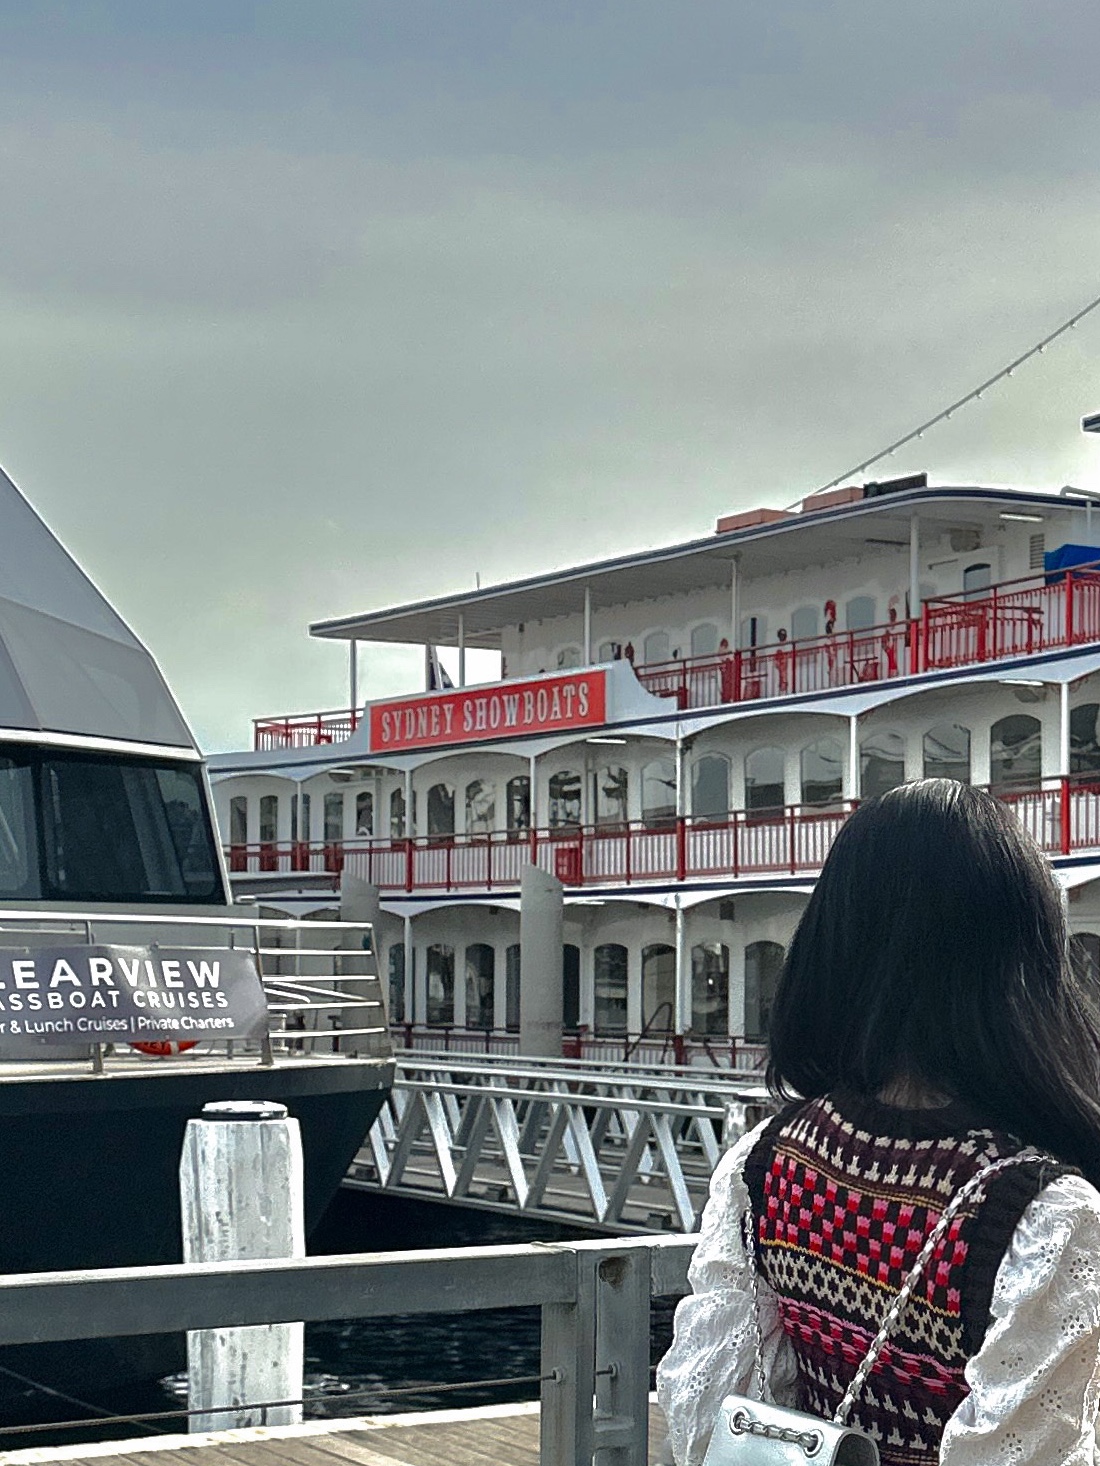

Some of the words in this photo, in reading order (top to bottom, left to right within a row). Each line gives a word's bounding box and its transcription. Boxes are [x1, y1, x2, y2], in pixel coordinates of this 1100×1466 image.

[381, 703, 454, 743] SYDNEY
[462, 681, 589, 732] SHOWBOATS
[0, 957, 220, 989] EARVIEW
[133, 990, 228, 1009] CRUISES
[9, 1020, 21, 1034] &
[25, 1018, 73, 1034] Lunch
[77, 1017, 128, 1032] Cruises
[138, 1016, 179, 1030] Private
[180, 1016, 235, 1030] Charters
